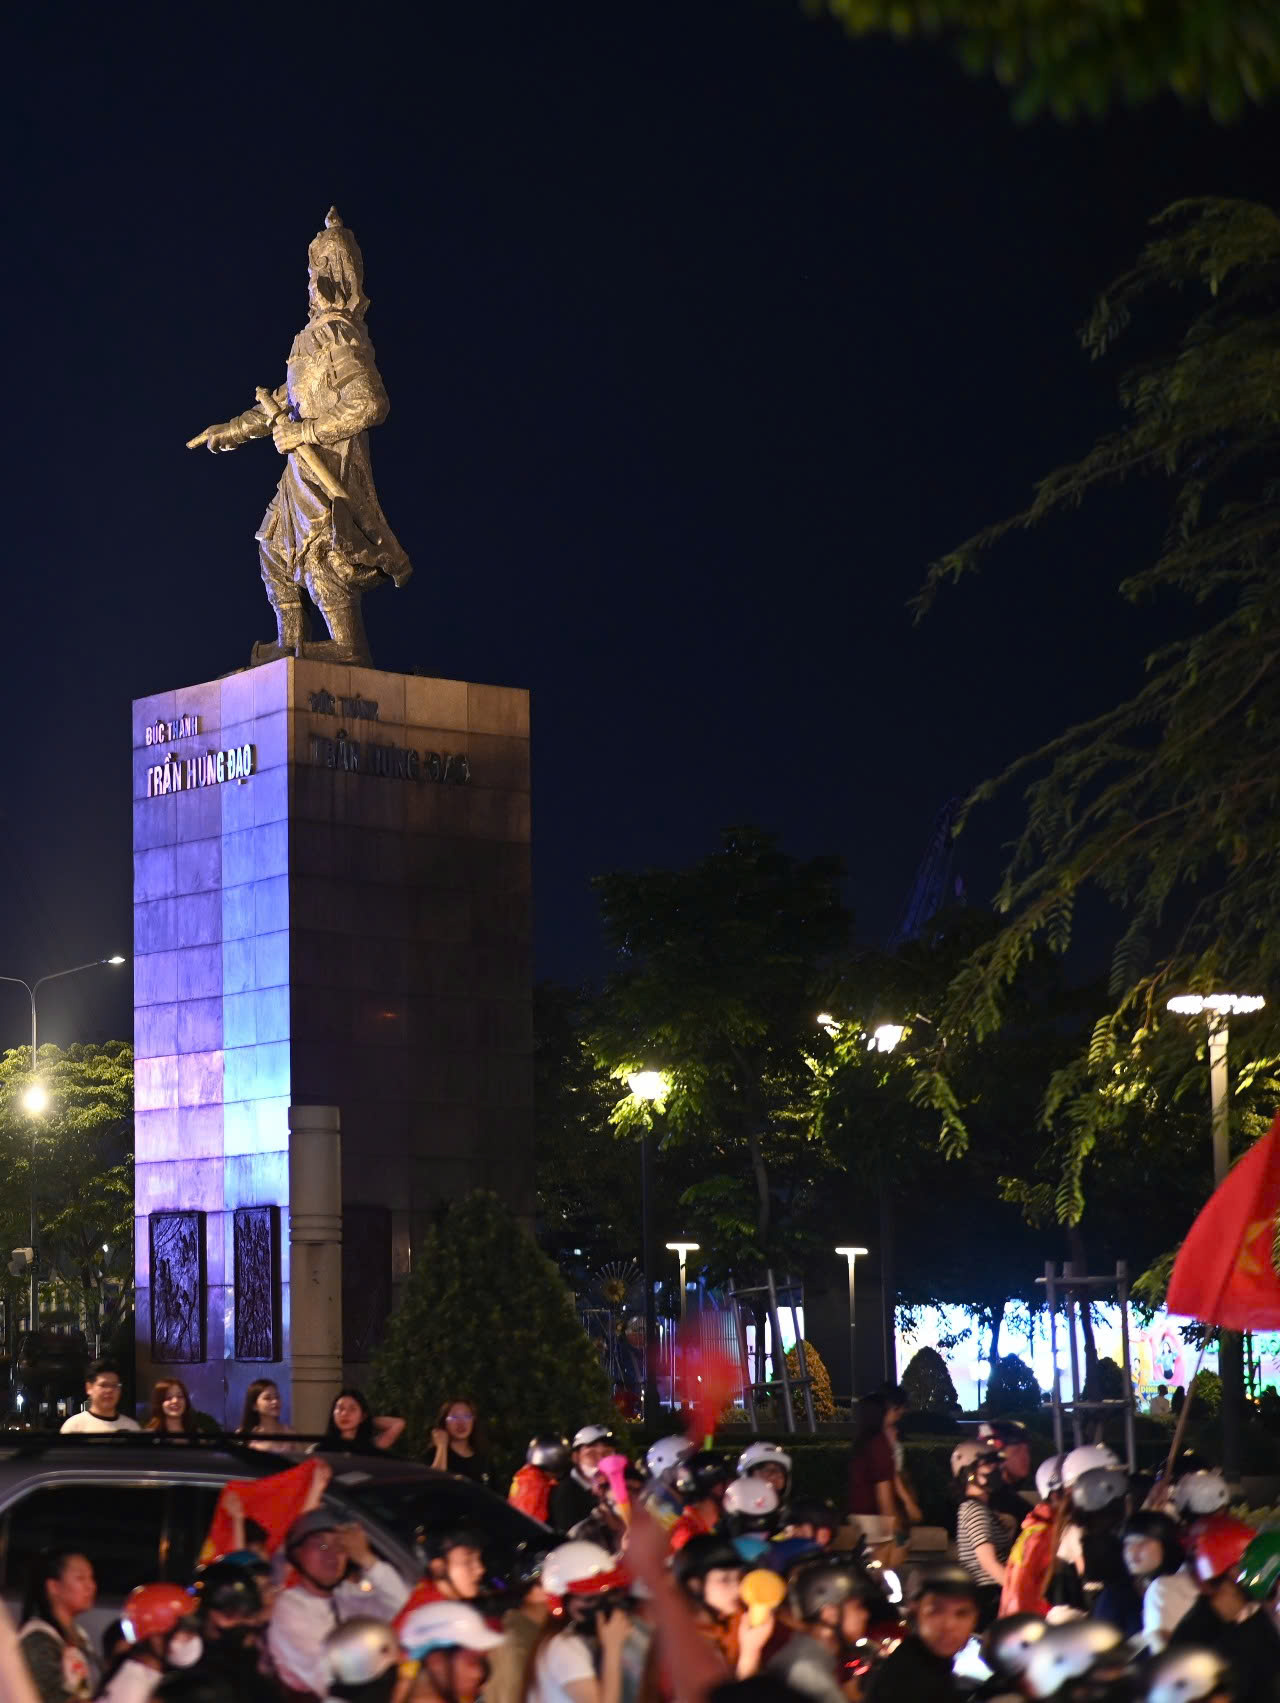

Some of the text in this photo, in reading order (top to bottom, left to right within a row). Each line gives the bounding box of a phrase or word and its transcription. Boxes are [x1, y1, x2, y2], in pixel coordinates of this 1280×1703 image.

[167, 713, 199, 741] THÁNH
[146, 752, 182, 798] TRẦN
[227, 744, 252, 786] ĐẠO
